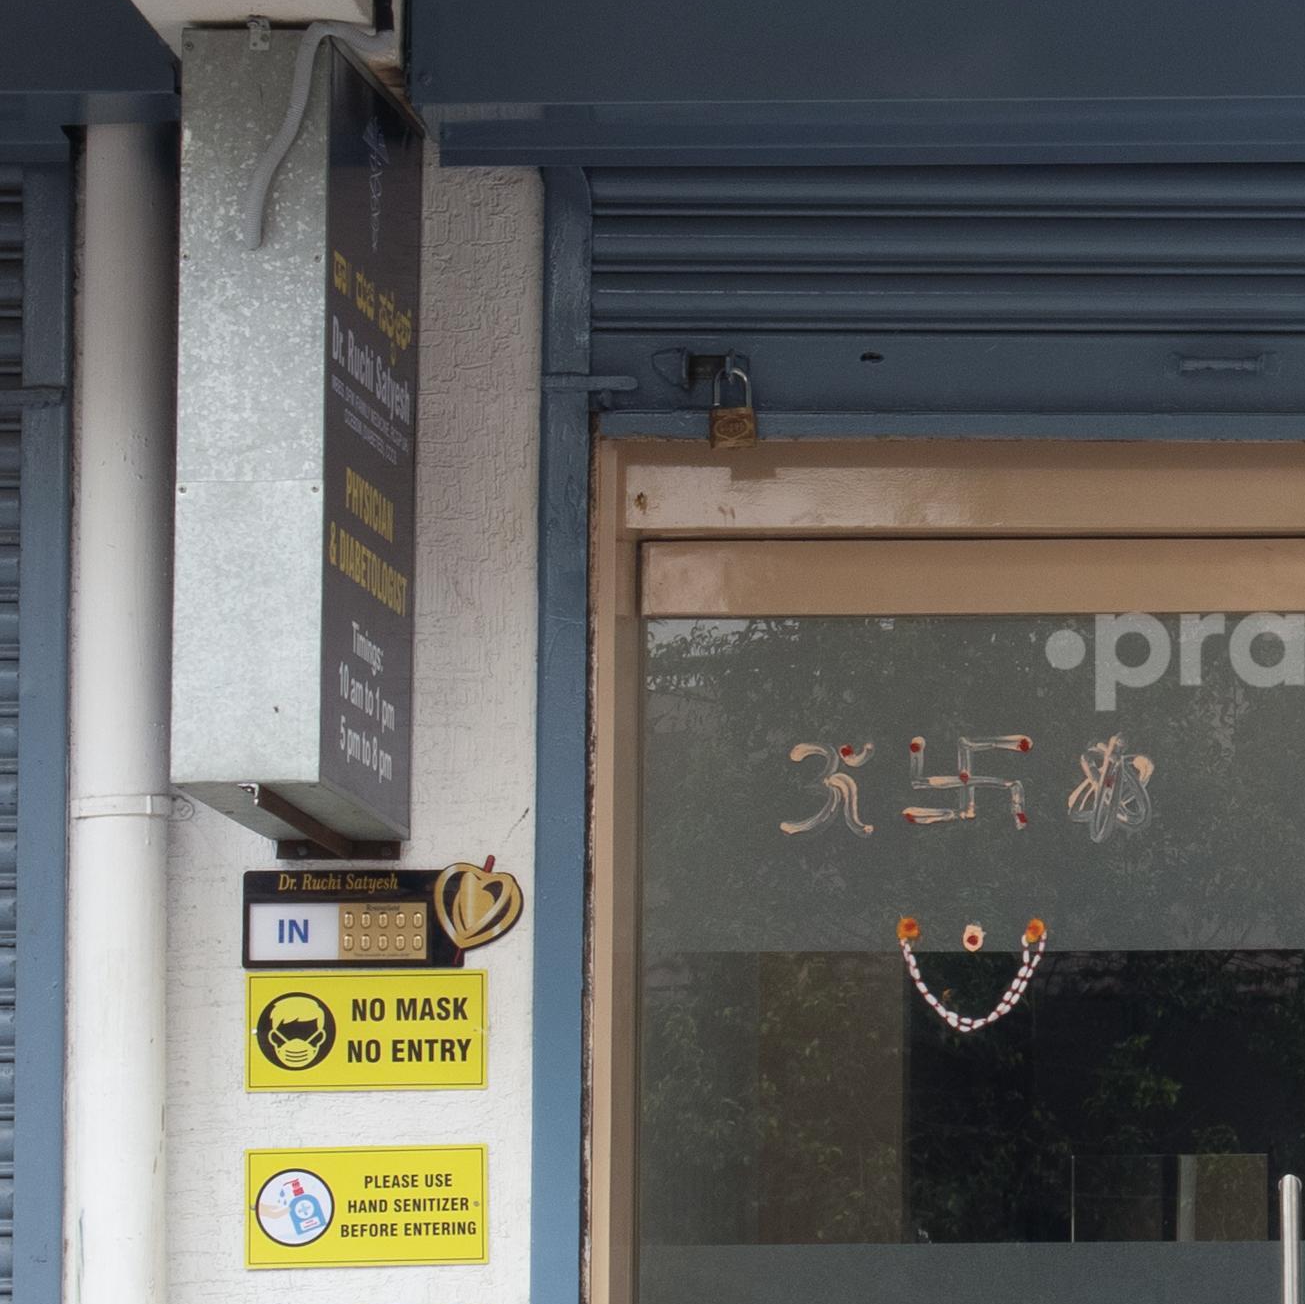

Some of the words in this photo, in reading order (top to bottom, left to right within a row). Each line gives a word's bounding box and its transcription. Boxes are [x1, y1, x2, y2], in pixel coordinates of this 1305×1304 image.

[332, 315, 345, 367] Dr.
[347, 329, 374, 392] Ruchi
[375, 355, 410, 426] Satyesh
[346, 466, 394, 544] PHYSICIAN
[330, 520, 338, 566] &
[340, 528, 408, 617] DIABETOLOGIST
[352, 620, 384, 676] Timings:
[339, 661, 349, 700] 10
[350, 678, 364, 710] am
[364, 680, 375, 717] to
[382, 699, 395, 734] pm
[340, 714, 346, 751] 5
[346, 728, 361, 764] pm
[362, 731, 371, 767] to
[372, 735, 378, 771] 8
[379, 749, 392, 784] pm
[277, 874, 297, 891] Dr.
[302, 873, 342, 891] Ruchi
[345, 873, 399, 895] Satyesh
[278, 919, 310, 944] IN
[352, 998, 385, 1021] NO
[397, 997, 467, 1020] MASK
[348, 1040, 380, 1063] NO
[392, 1039, 471, 1062] ENTRY
[365, 1175, 418, 1188] PLEASE
[425, 1174, 452, 1187] USE
[348, 1200, 387, 1213] HAND
[394, 1198, 468, 1212] SENITIZER
[341, 1223, 397, 1237] BEFORE
[405, 1221, 476, 1236] ENTERING
